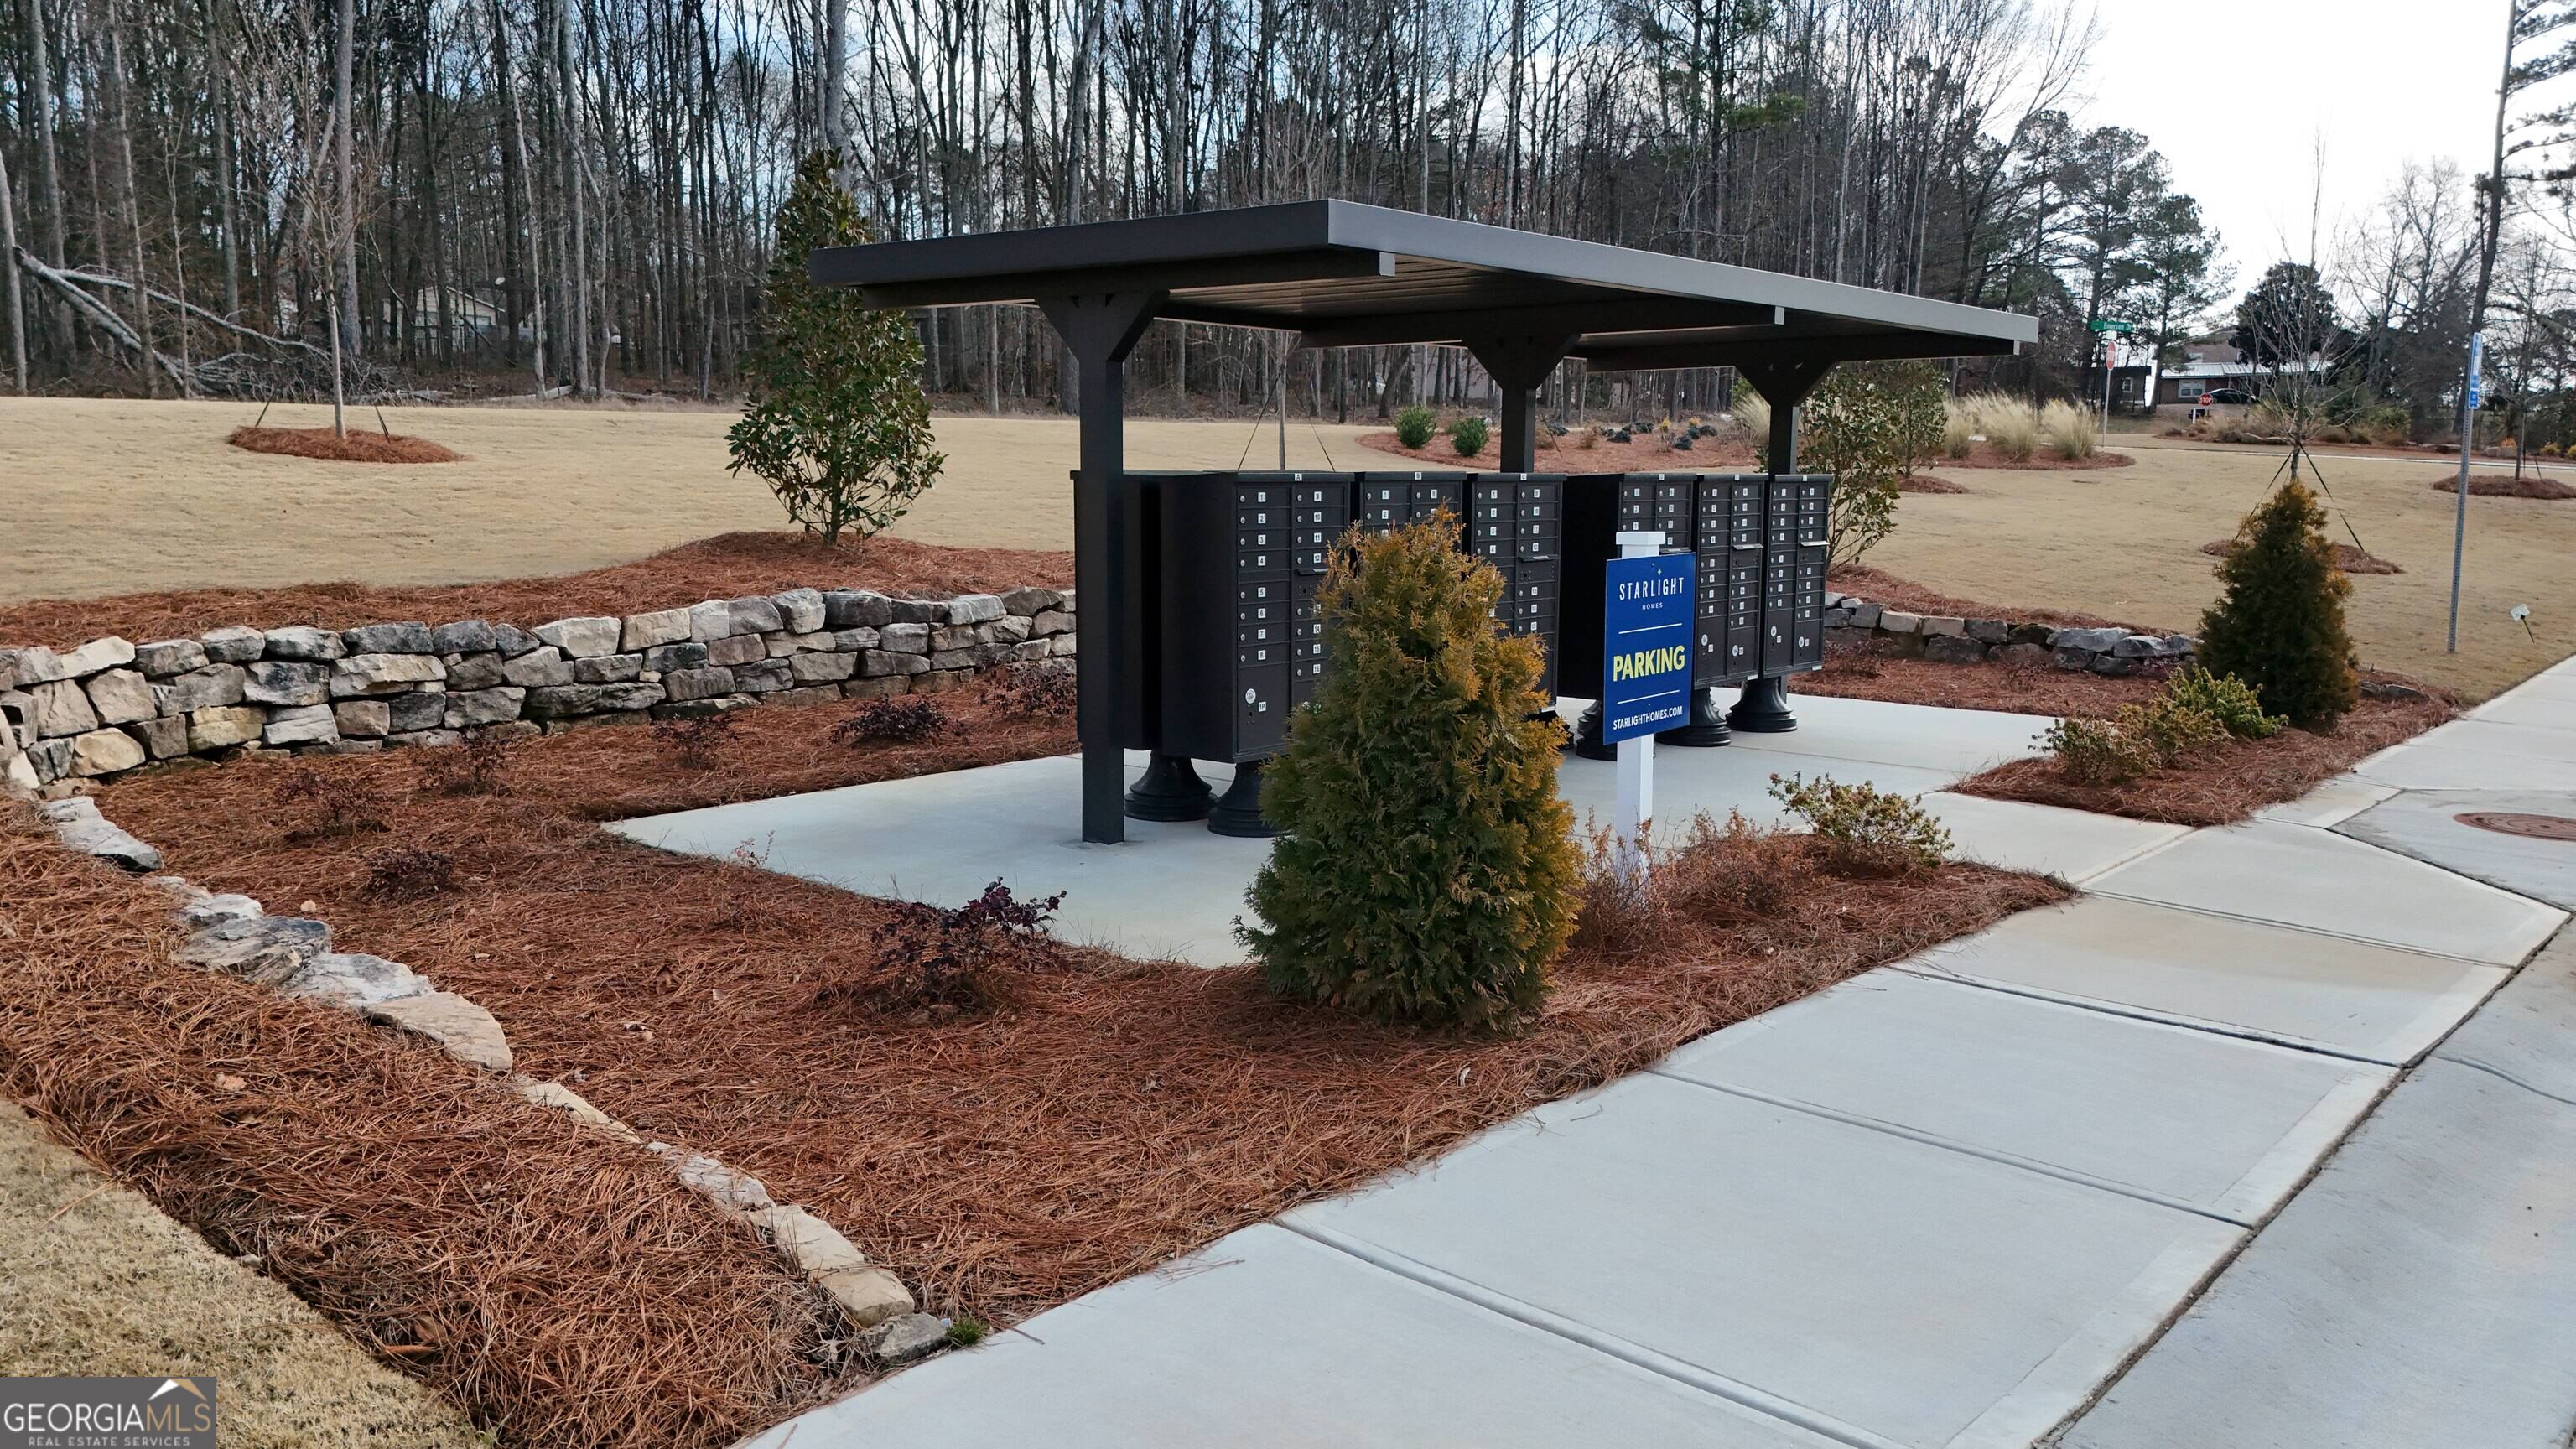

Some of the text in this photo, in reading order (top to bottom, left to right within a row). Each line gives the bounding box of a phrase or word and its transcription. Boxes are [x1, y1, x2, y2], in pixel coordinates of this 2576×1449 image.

[2103, 322, 2124, 330] Emerson
[1618, 577, 1685, 600] STARLIGHT
[1612, 645, 1685, 682] PARKING
[1613, 705, 1683, 730] STARLIGHTHOMES.COM
